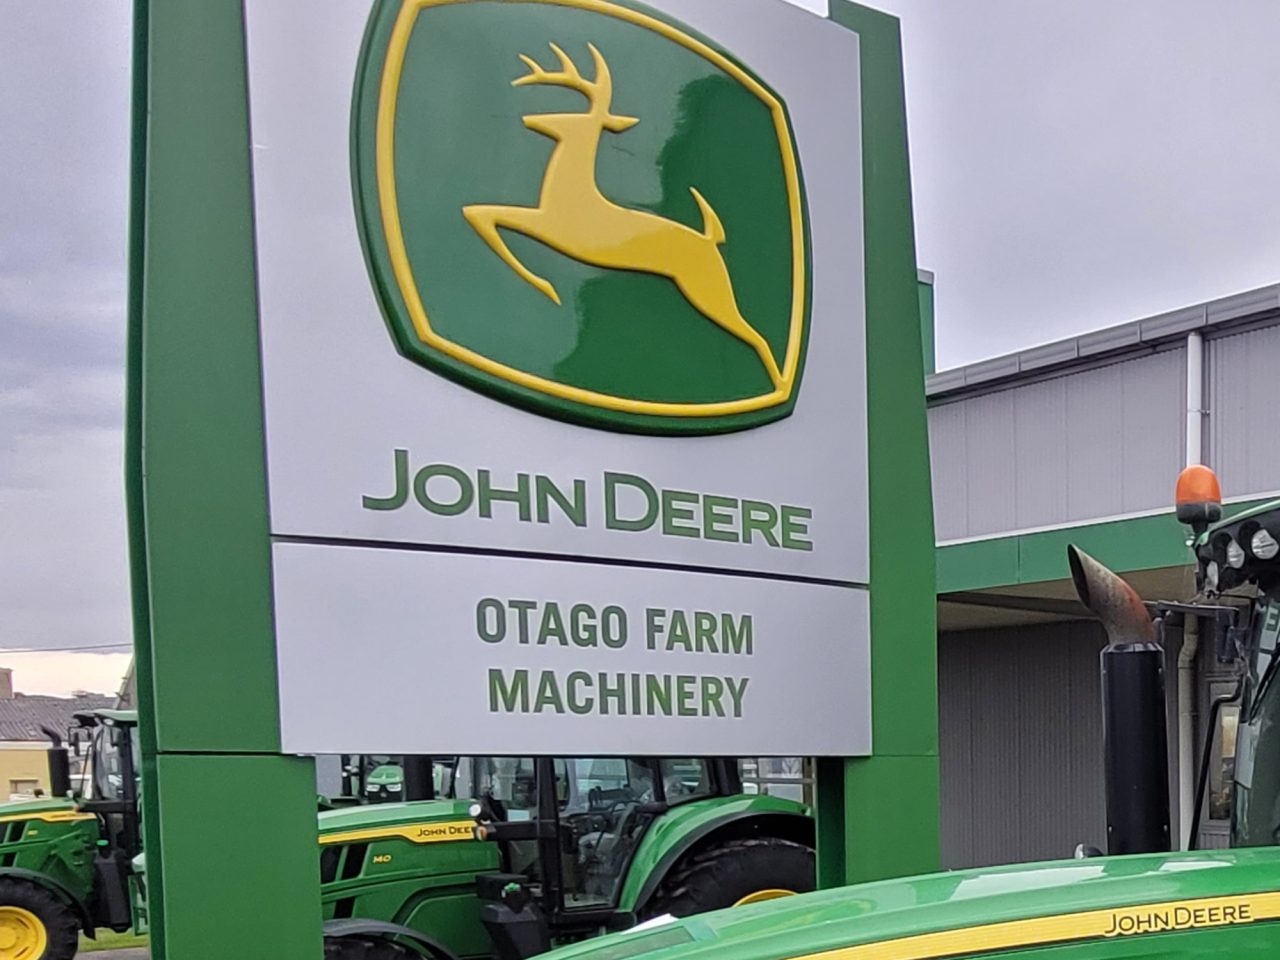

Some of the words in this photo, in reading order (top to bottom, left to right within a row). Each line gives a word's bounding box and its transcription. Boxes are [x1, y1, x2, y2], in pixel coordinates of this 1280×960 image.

[362, 449, 587, 527] JOHN
[604, 471, 813, 551] DEERE
[476, 598, 628, 649] OTAGO
[646, 607, 753, 655] FARM
[488, 668, 749, 717] MACHINERY
[417, 828, 446, 837] JOHN
[1105, 913, 1168, 933] JOHN
[1174, 904, 1250, 925] DEERE
